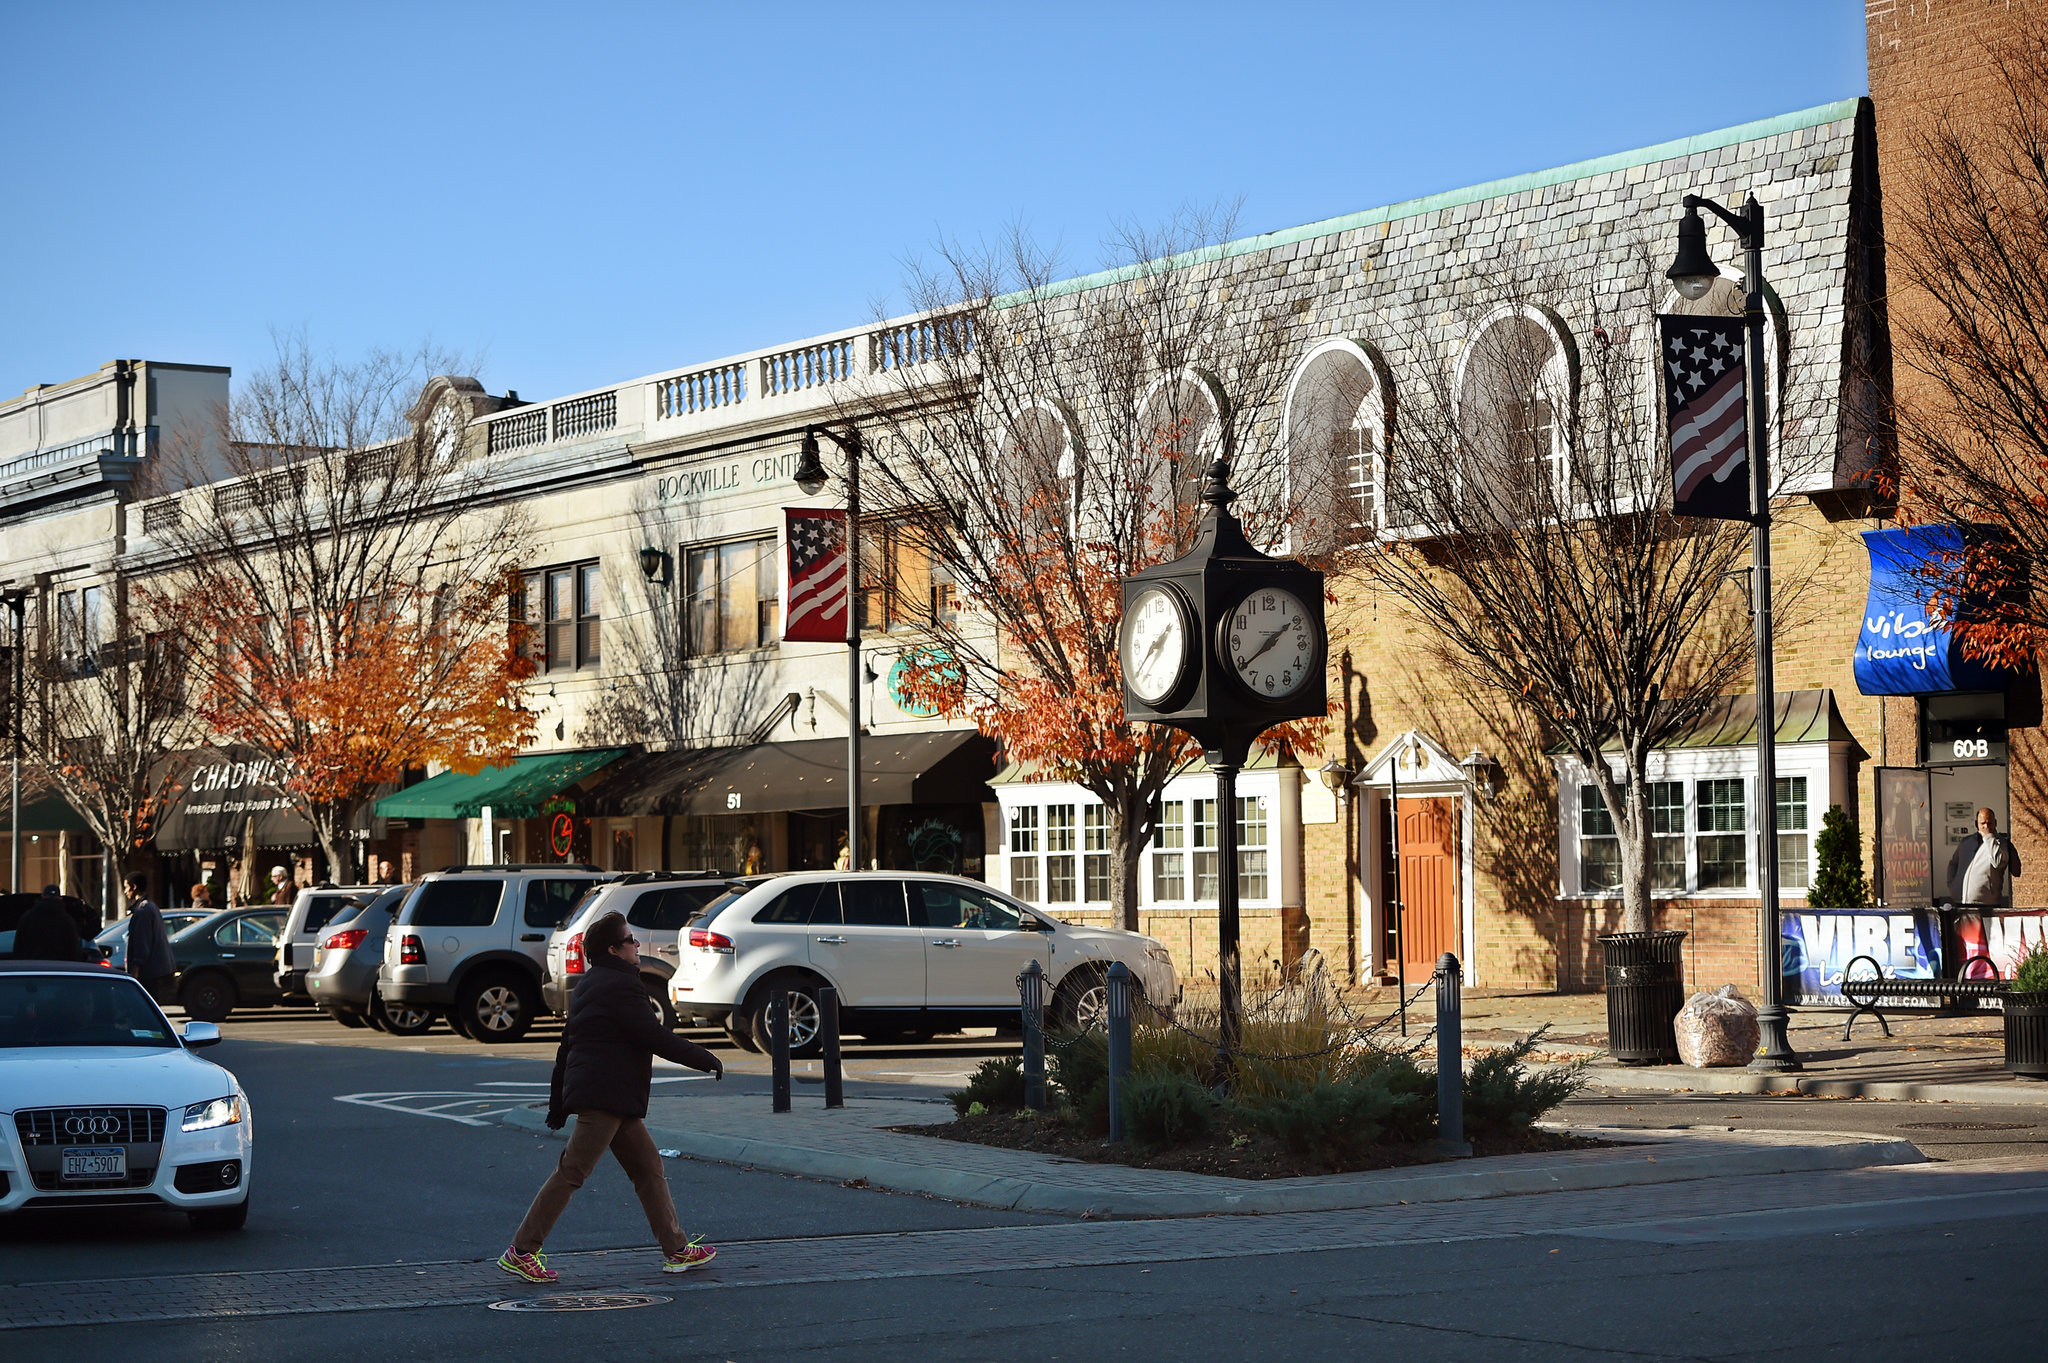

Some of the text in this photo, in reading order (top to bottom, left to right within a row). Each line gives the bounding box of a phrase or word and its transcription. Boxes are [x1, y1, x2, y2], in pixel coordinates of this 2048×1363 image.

[657, 464, 741, 501] ROCKVILLE
[752, 451, 805, 484] CENTR
[835, 434, 902, 467] OICE
[1248, 600, 1256, 615] 11
[1262, 595, 1276, 611] 12
[1236, 614, 1247, 630] 10
[1292, 615, 1302, 631] 2
[1232, 634, 1241, 651] 9
[1296, 634, 1307, 651] 3
[1293, 656, 1302, 670] 4
[1867, 645, 1936, 670] lounge
[1249, 670, 1259, 686] 7
[1265, 675, 1275, 691] 6
[1282, 670, 1291, 686] 5
[1953, 739, 1989, 758] 60-B
[191, 758, 305, 792] CHADWIC
[184, 803, 222, 816] American
[222, 801, 245, 814] Chop
[245, 799, 271, 811] House
[272, 798, 280, 809] &
[727, 793, 741, 809] 51
[963, 907, 983, 921] AT
[1800, 914, 1916, 970] VIBE
[68, 1156, 119, 1172] EHZ 5907
